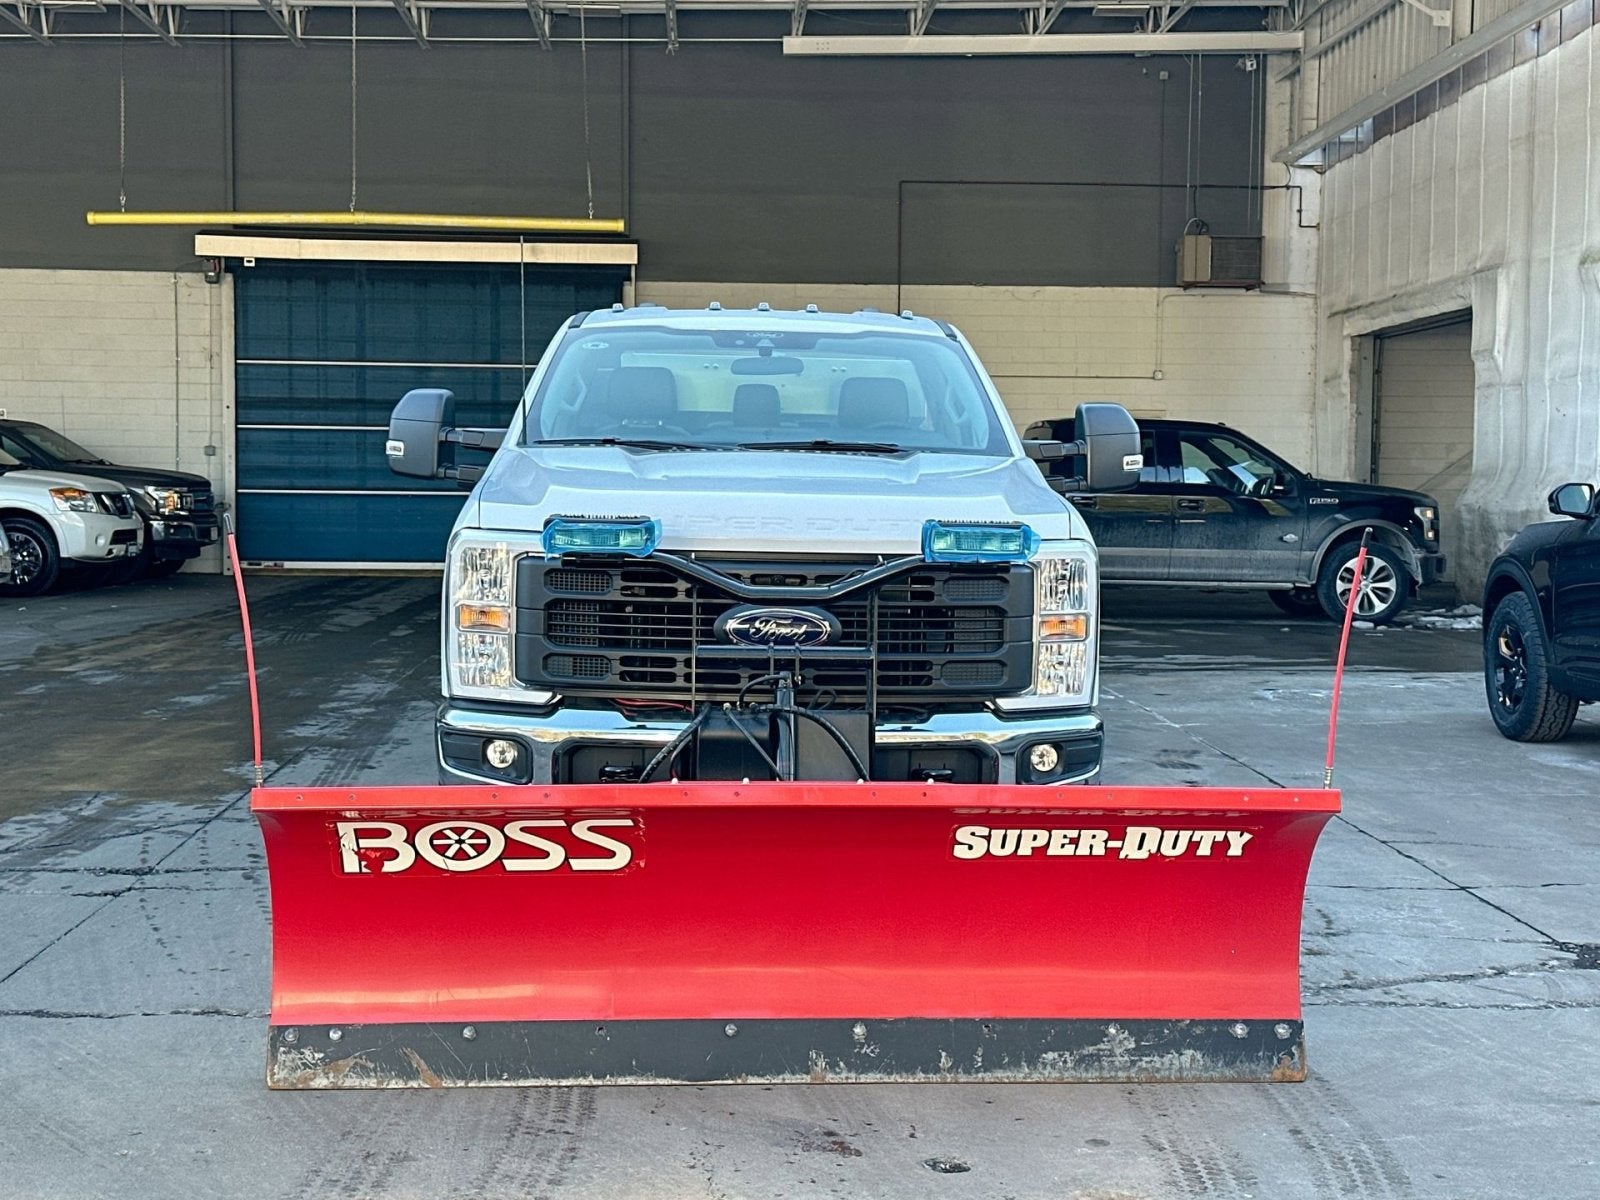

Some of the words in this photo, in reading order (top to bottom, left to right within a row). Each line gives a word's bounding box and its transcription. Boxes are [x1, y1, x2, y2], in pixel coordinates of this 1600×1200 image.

[750, 617, 808, 640] Ford
[336, 819, 634, 873] BOSS
[953, 825, 1254, 860] SUPER-DUTY
